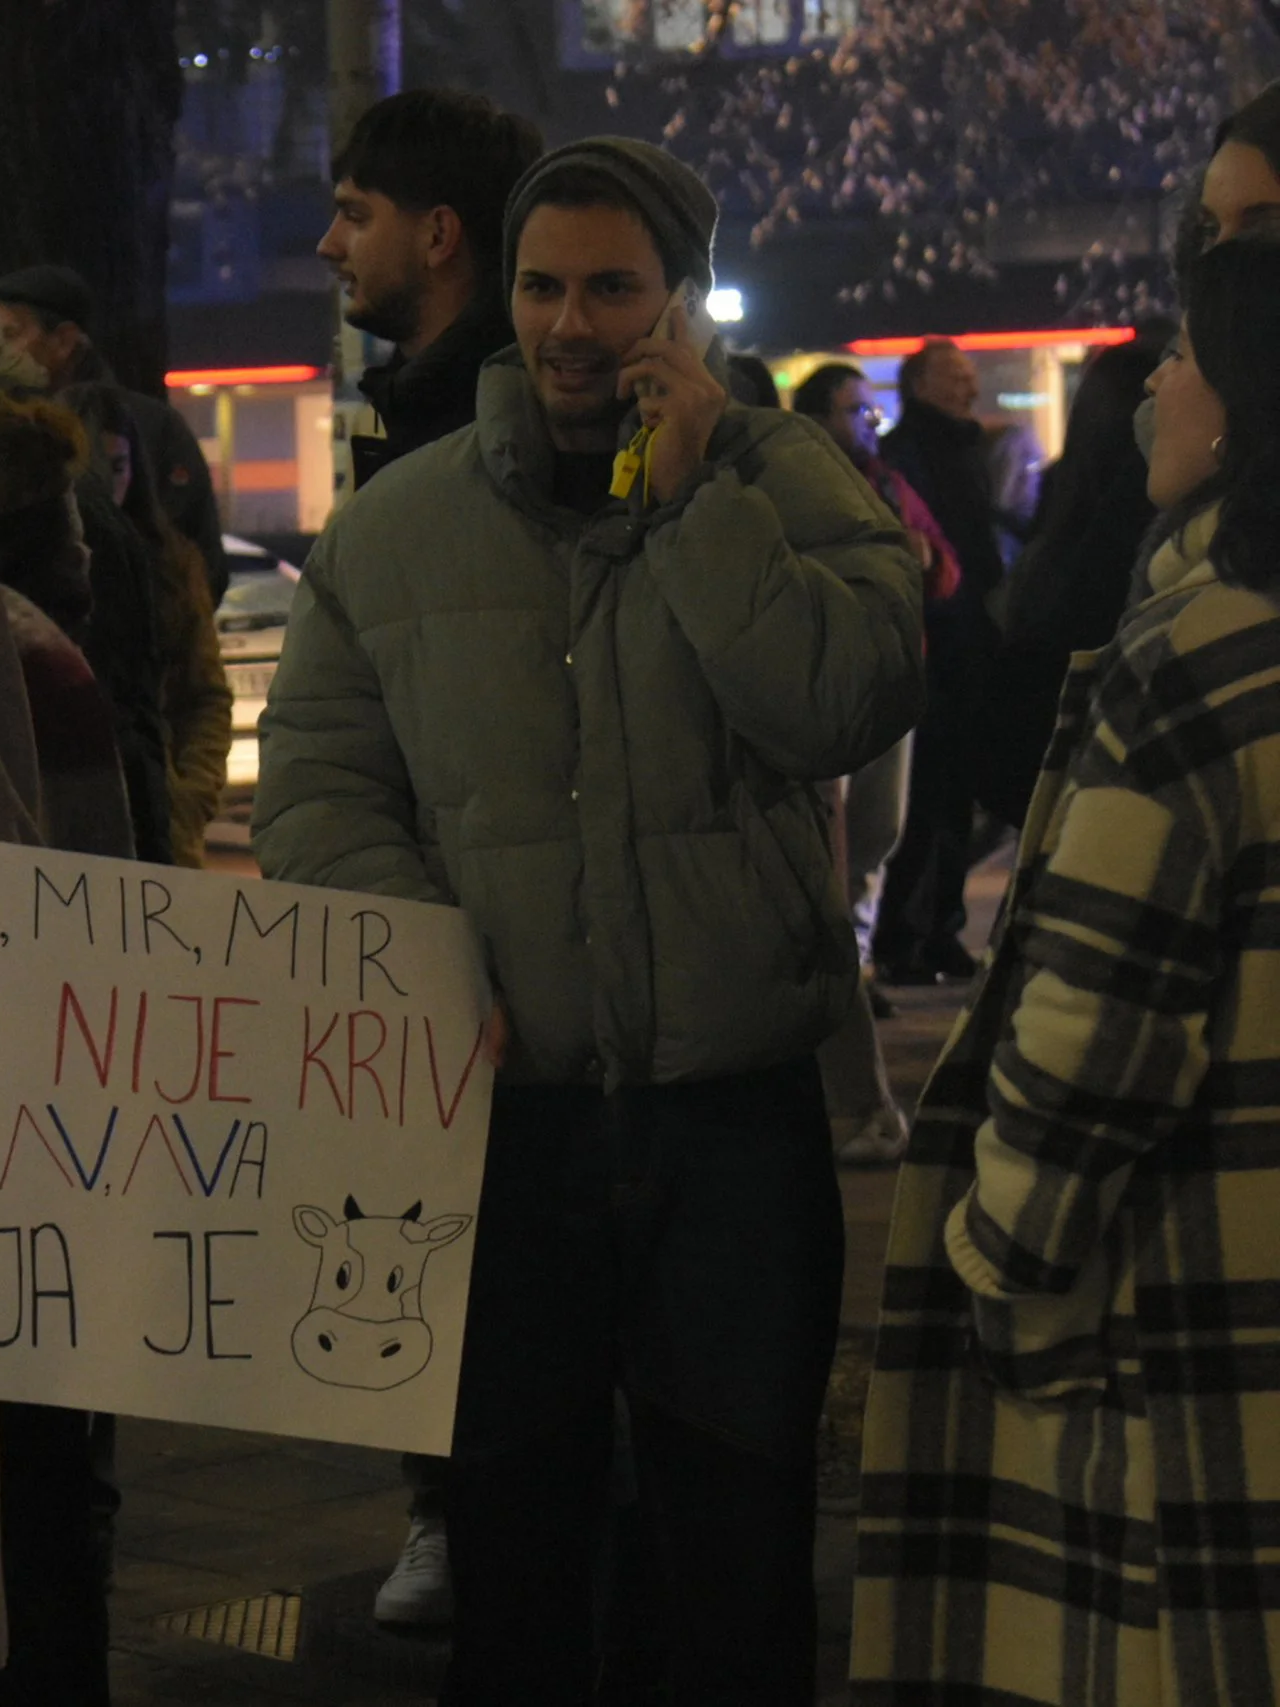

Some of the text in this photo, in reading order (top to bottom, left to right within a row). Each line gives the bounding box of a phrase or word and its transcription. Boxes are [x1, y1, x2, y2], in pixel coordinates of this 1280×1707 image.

[33, 866, 202, 966] MIR,
[225, 889, 409, 1002] MIR
[53, 980, 261, 1105] NIJE
[297, 1005, 485, 1130] KRIV
[142, 1230, 259, 1359] JE
